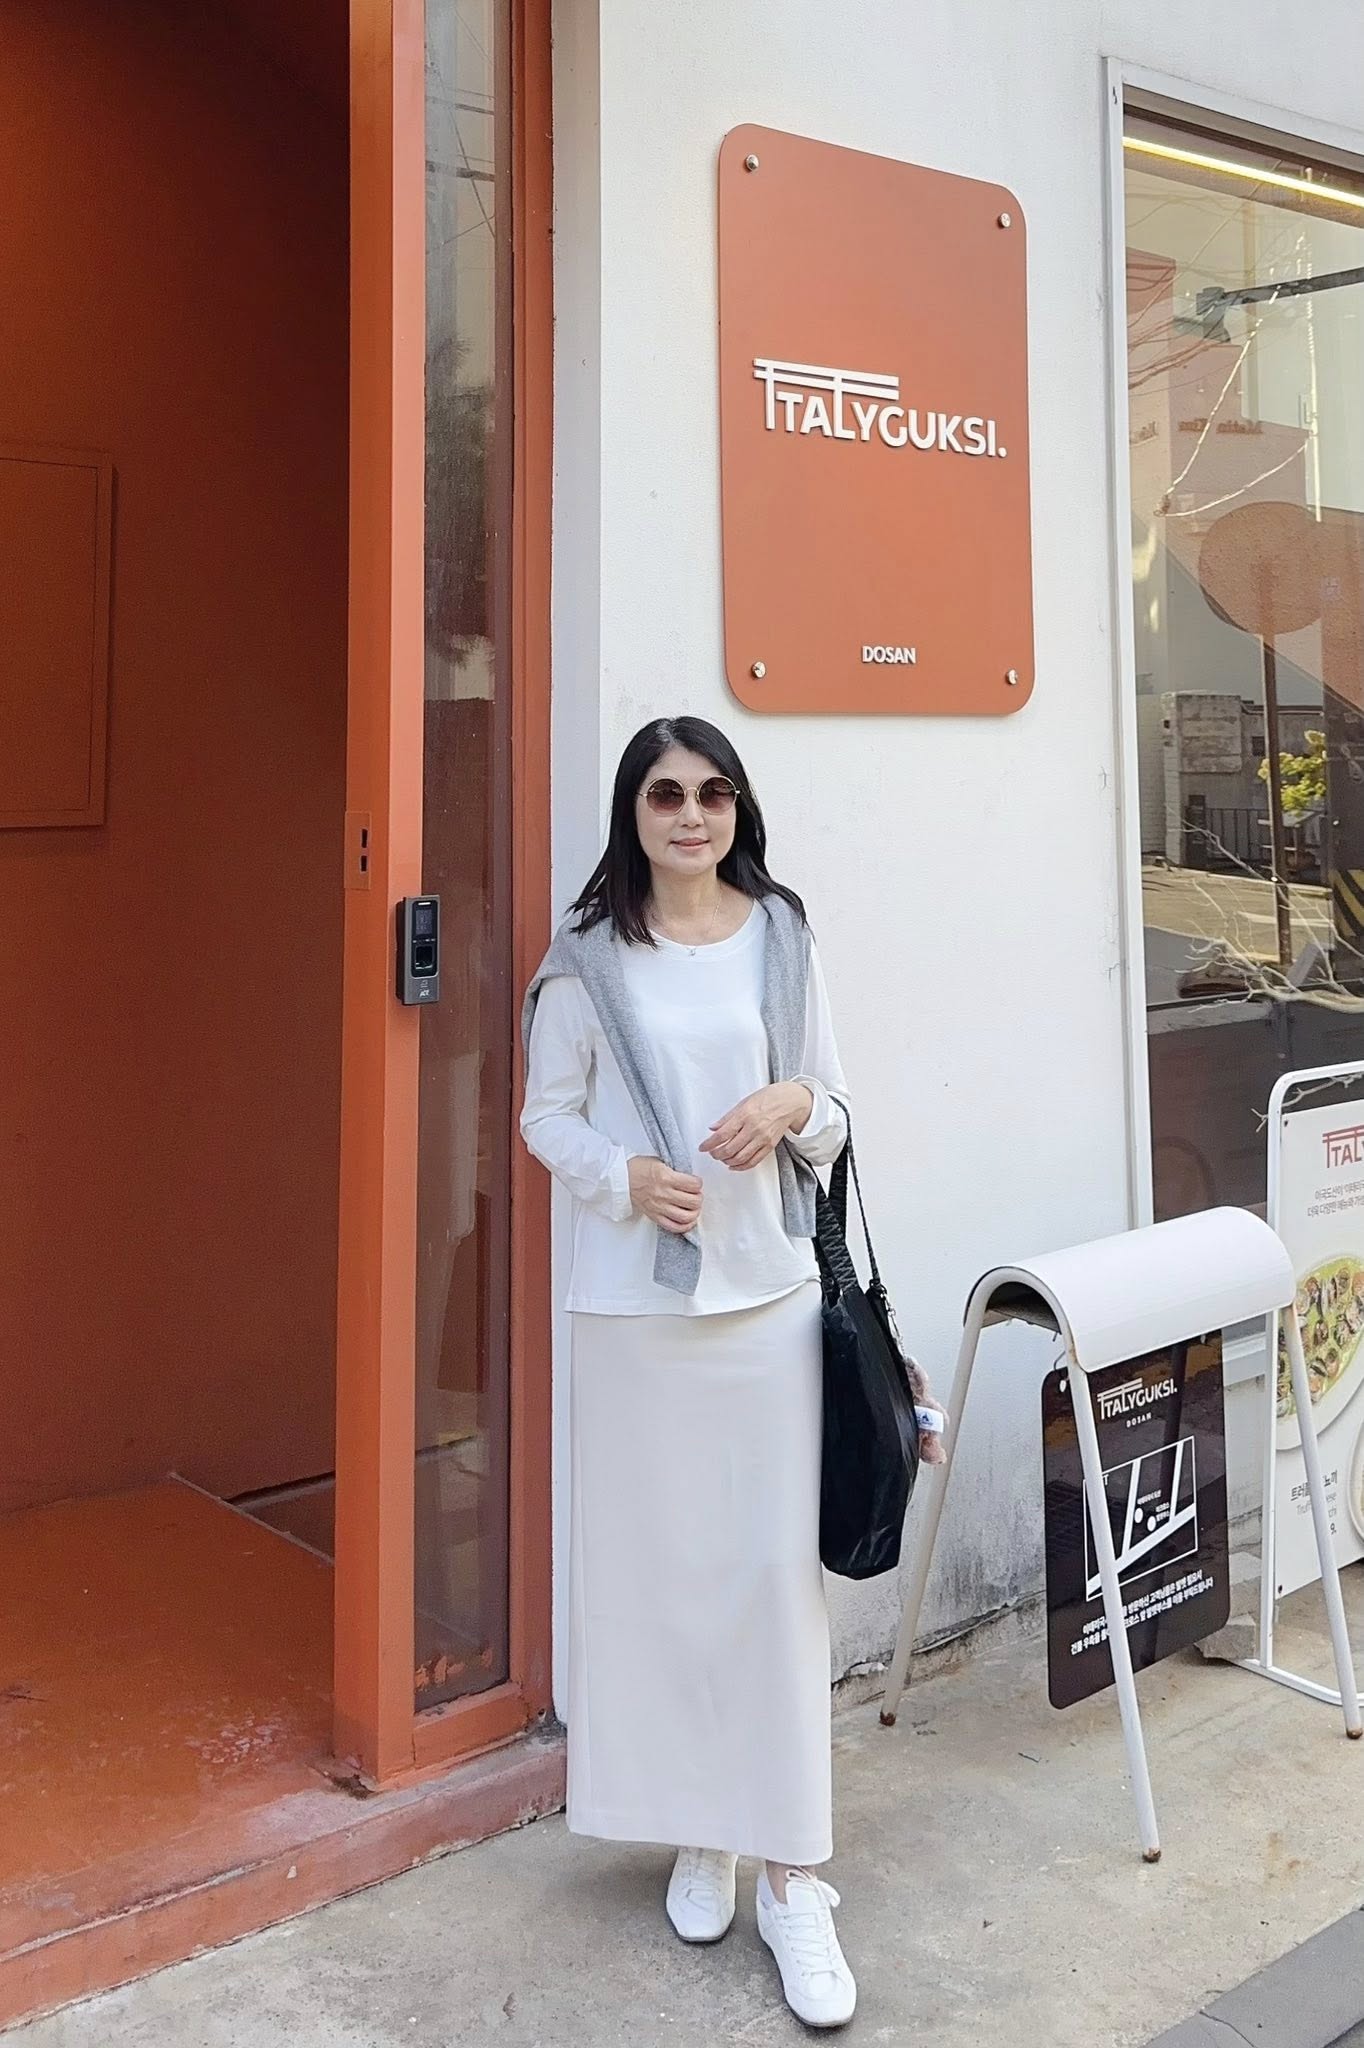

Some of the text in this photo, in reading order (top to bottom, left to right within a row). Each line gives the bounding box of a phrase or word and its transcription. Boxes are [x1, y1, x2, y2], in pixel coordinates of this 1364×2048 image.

[753, 358, 1007, 458] ITALYGUKSI.
[861, 645, 916, 665] DOSAN
[1097, 1377, 1178, 1420] ITALYGUKSI.
[1126, 1412, 1152, 1428] DOSAN
